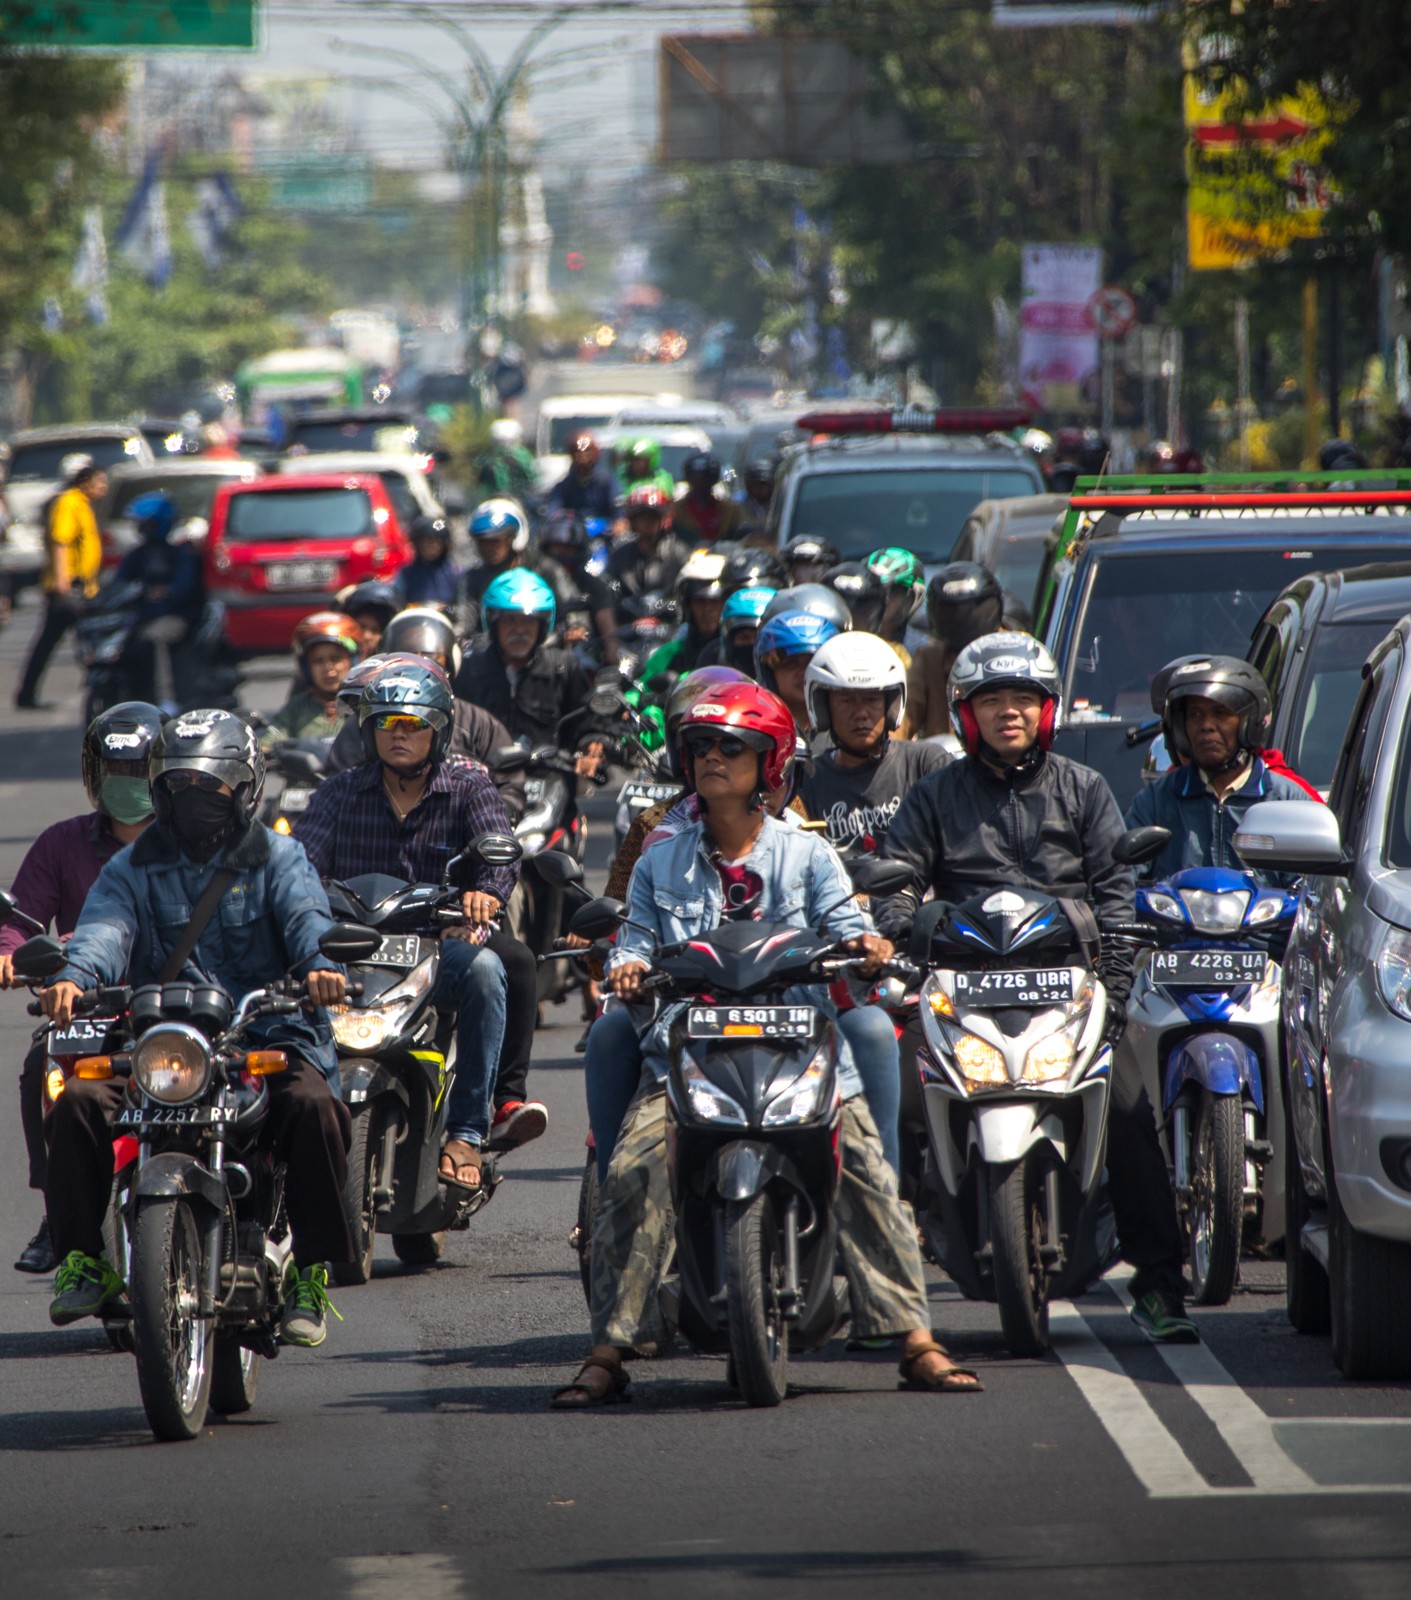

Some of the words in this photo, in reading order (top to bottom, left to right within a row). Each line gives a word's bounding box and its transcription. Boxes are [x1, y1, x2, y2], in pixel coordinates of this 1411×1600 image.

[405, 938, 415, 953] F
[1156, 954, 1178, 968] AB
[1190, 953, 1233, 968] 4226
[1242, 954, 1263, 968] UA
[957, 974, 968, 988] D
[980, 974, 1027, 989] 4726
[1036, 971, 1070, 986] UBR
[693, 1010, 717, 1023] AB
[119, 1109, 143, 1122] AB
[152, 1108, 199, 1122] 2257
[210, 1107, 234, 1122] RY
